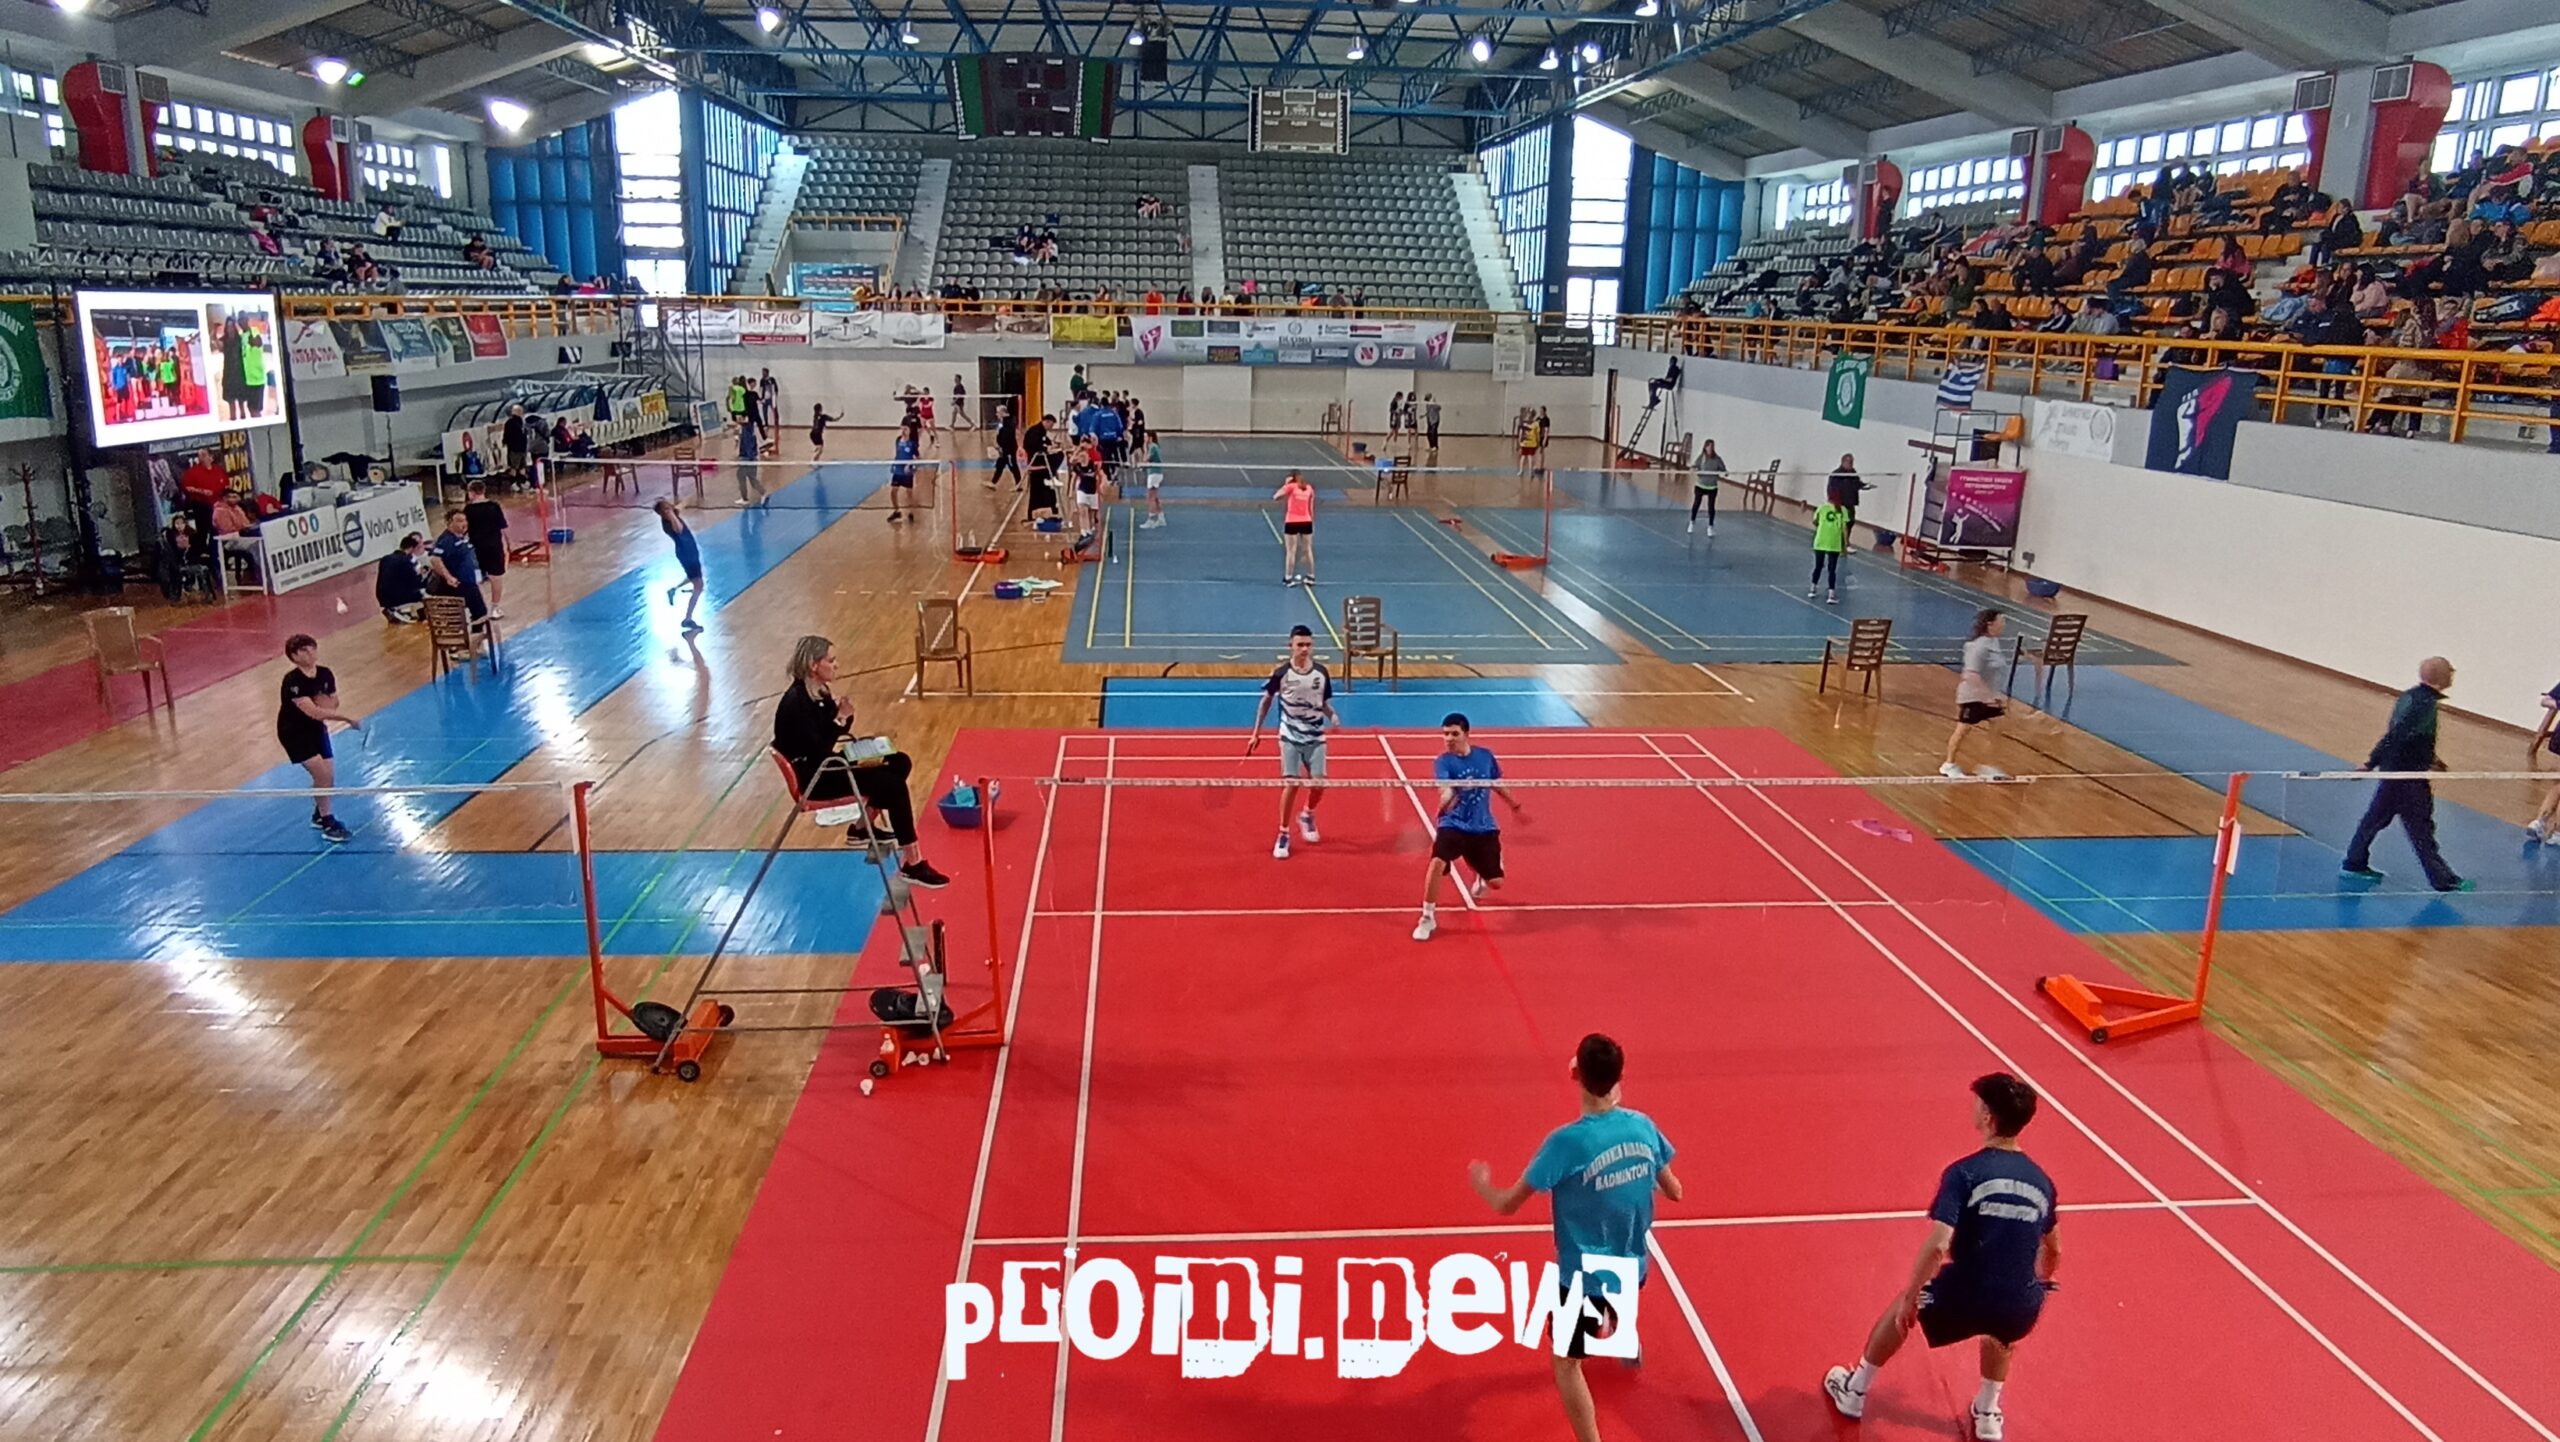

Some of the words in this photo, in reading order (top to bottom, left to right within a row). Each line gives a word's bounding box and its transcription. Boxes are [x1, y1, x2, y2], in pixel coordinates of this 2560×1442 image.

[396, 511, 410, 529] for
[409, 506, 425, 523] life
[1595, 1161, 1649, 1191] BADMINTON
